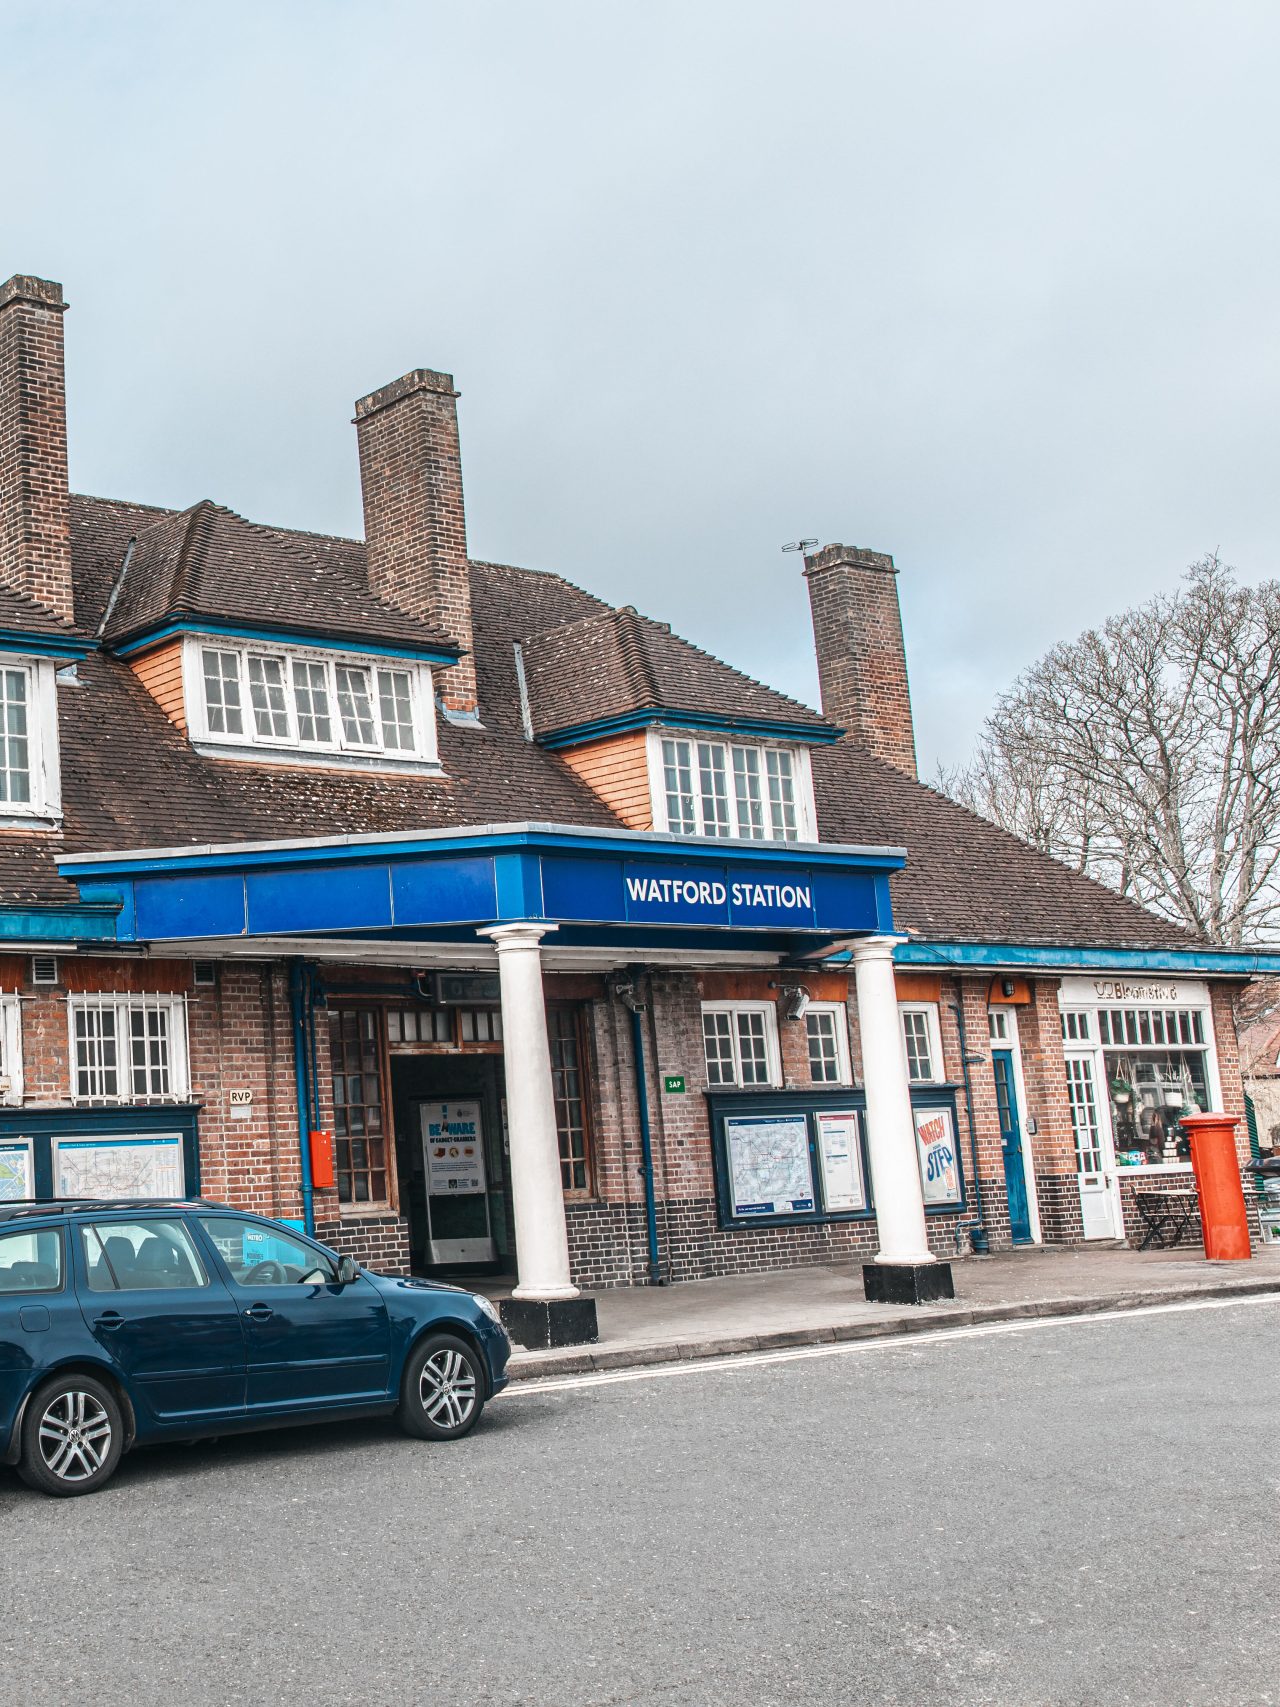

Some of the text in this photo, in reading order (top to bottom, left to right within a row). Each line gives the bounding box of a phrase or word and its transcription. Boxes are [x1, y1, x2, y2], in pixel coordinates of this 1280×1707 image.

[626, 878, 811, 908] WATFORD STATION
[232, 1092, 250, 1101] RVP
[918, 1116, 946, 1146] WATCH
[928, 1147, 952, 1181] STEP
